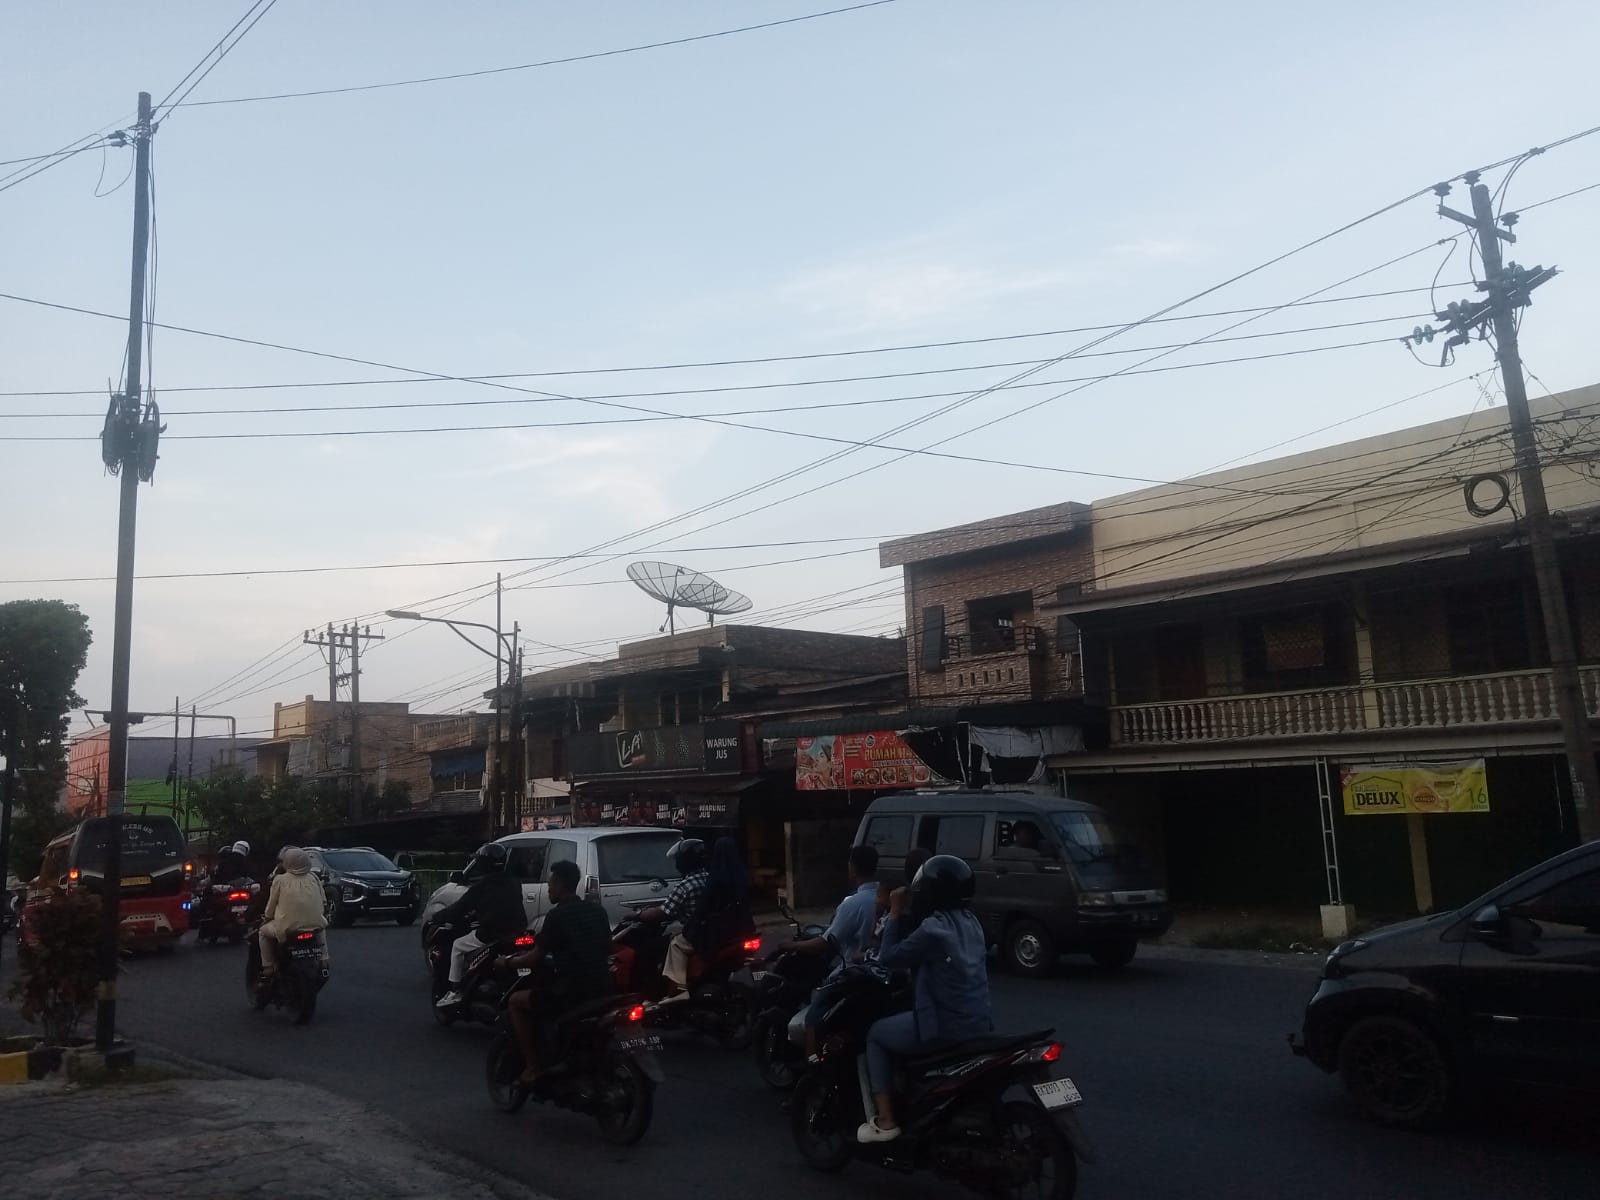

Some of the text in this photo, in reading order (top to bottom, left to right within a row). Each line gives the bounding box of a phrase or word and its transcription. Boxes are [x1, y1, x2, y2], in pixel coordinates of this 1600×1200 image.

[706, 737, 738, 749] WARUNG
[715, 749, 728, 760] JUS
[864, 748, 897, 761] RUMAH
[1356, 791, 1401, 806] DELUX
[1466, 786, 1487, 804] 16
[699, 803, 726, 813] WARUNG
[699, 810, 711, 819] JUS
